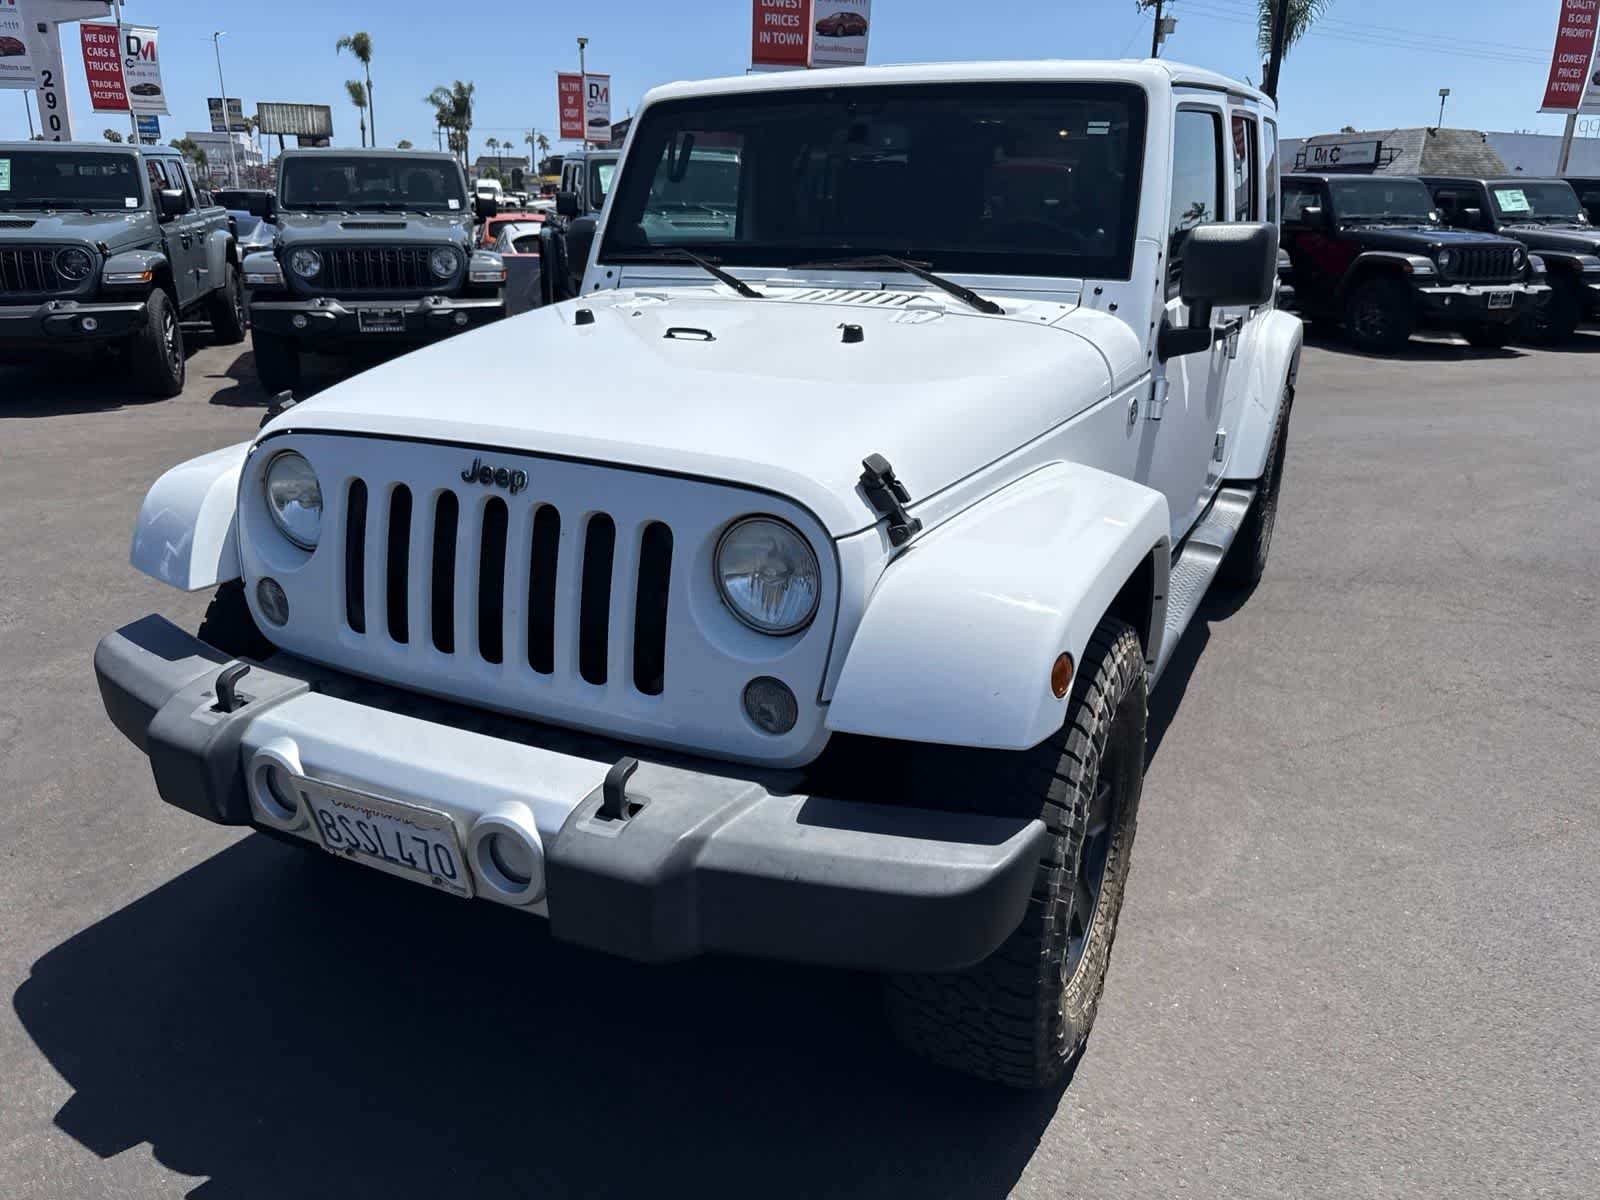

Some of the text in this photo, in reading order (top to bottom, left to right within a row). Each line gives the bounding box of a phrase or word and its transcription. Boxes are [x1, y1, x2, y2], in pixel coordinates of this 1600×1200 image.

[761, 0, 802, 8] LOWEST
[765, 13, 800, 26] PRICES
[1561, 27, 1594, 39] PRIORITY
[85, 34, 116, 44] WE BUY
[760, 32, 803, 45] IN TOWN
[87, 47, 116, 57] CARS &
[1558, 54, 1587, 64] LOWEST
[88, 62, 119, 72] TRUCKS
[1558, 68, 1582, 78] PRICES
[91, 79, 121, 89] TRADE-IN
[1551, 82, 1581, 92] IN TOWN
[93, 91, 124, 100] ACCEPTED
[461, 456, 528, 496] Jeep
[318, 809, 456, 879] 8SSL470
